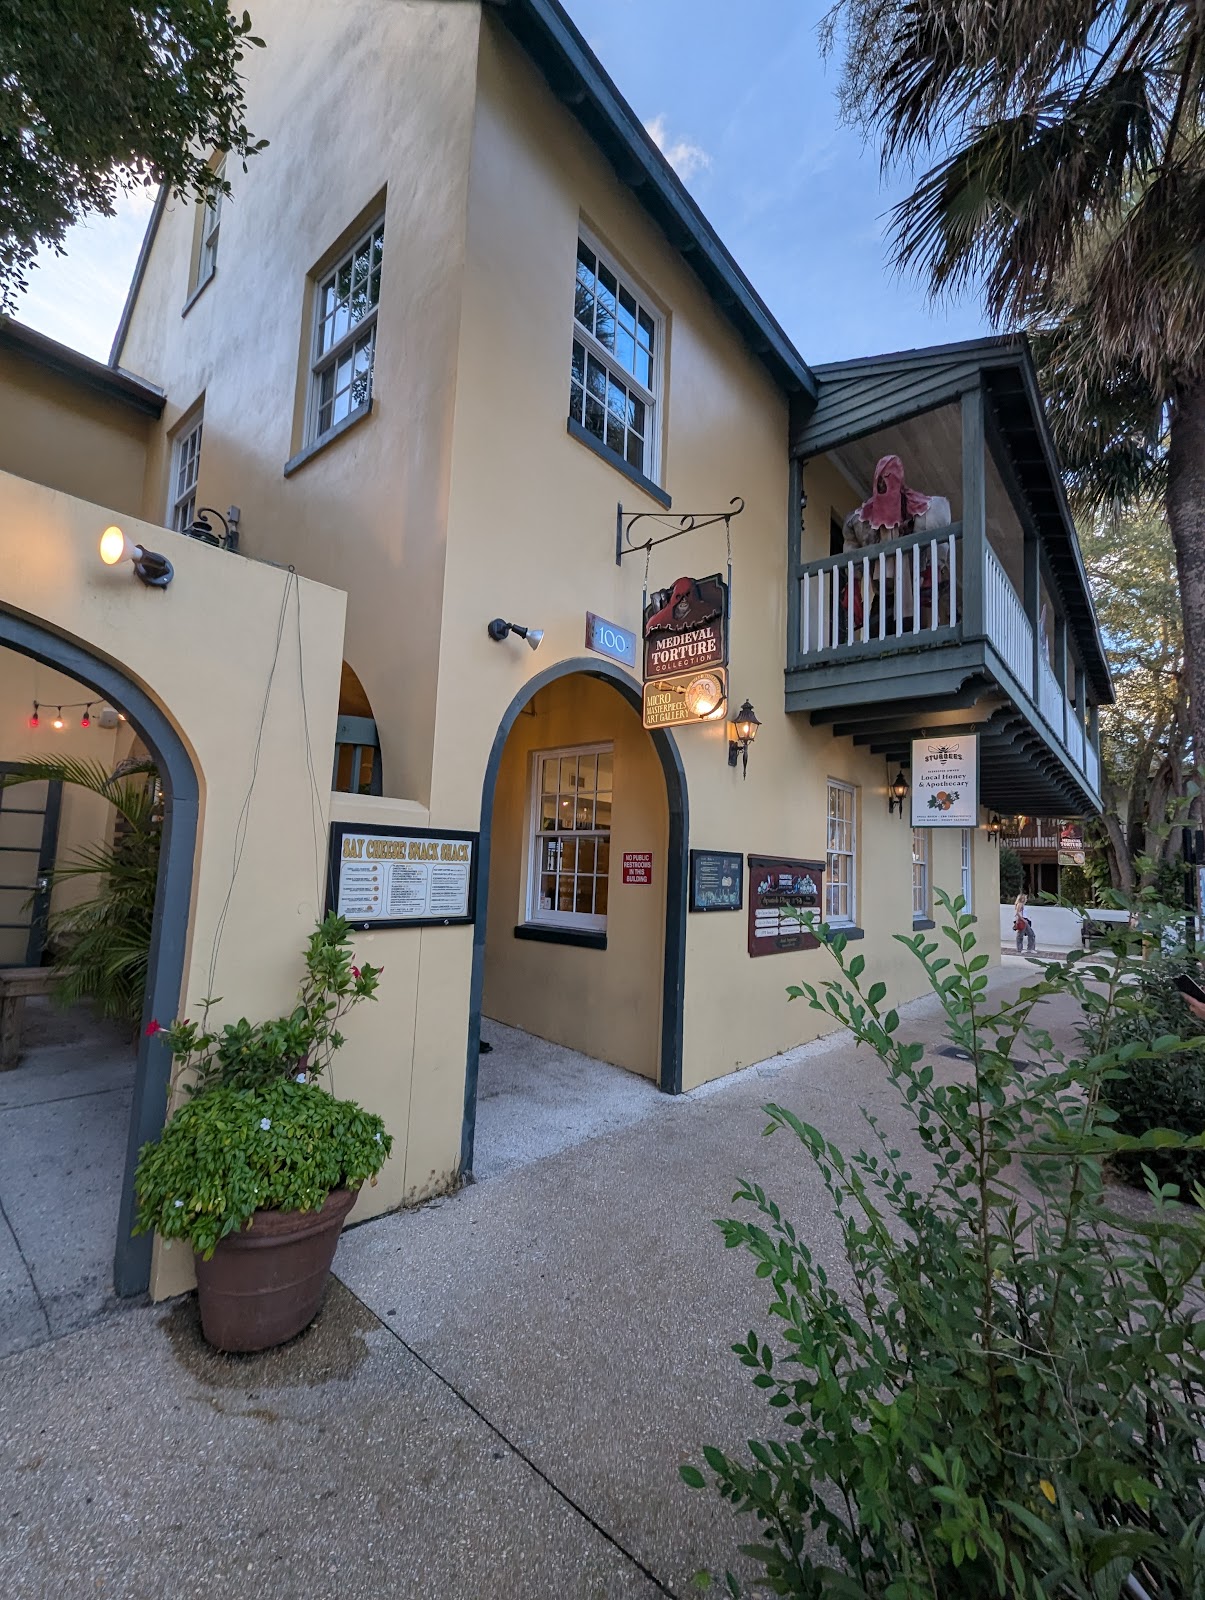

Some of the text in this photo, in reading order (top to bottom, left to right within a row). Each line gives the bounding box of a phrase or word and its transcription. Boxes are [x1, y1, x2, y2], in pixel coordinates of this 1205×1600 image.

[599, 627, 625, 652] 100
[656, 627, 714, 650] MEDIEVAL
[652, 638, 716, 665] TORTURE
[656, 654, 712, 671] COLLECTION
[647, 693, 671, 707] MICRO
[646, 701, 687, 715] MASTERPIECES
[646, 709, 690, 724] ART GALLERY
[925, 754, 963, 762] STUBBEES
[926, 780, 969, 788] Apothecary
[343, 838, 365, 858] SAY
[441, 843, 470, 862] SHACK
[623, 861, 652, 869] RESTROOMS
[625, 854, 650, 862] NO PUBLIC
[628, 868, 645, 876] IN THIS
